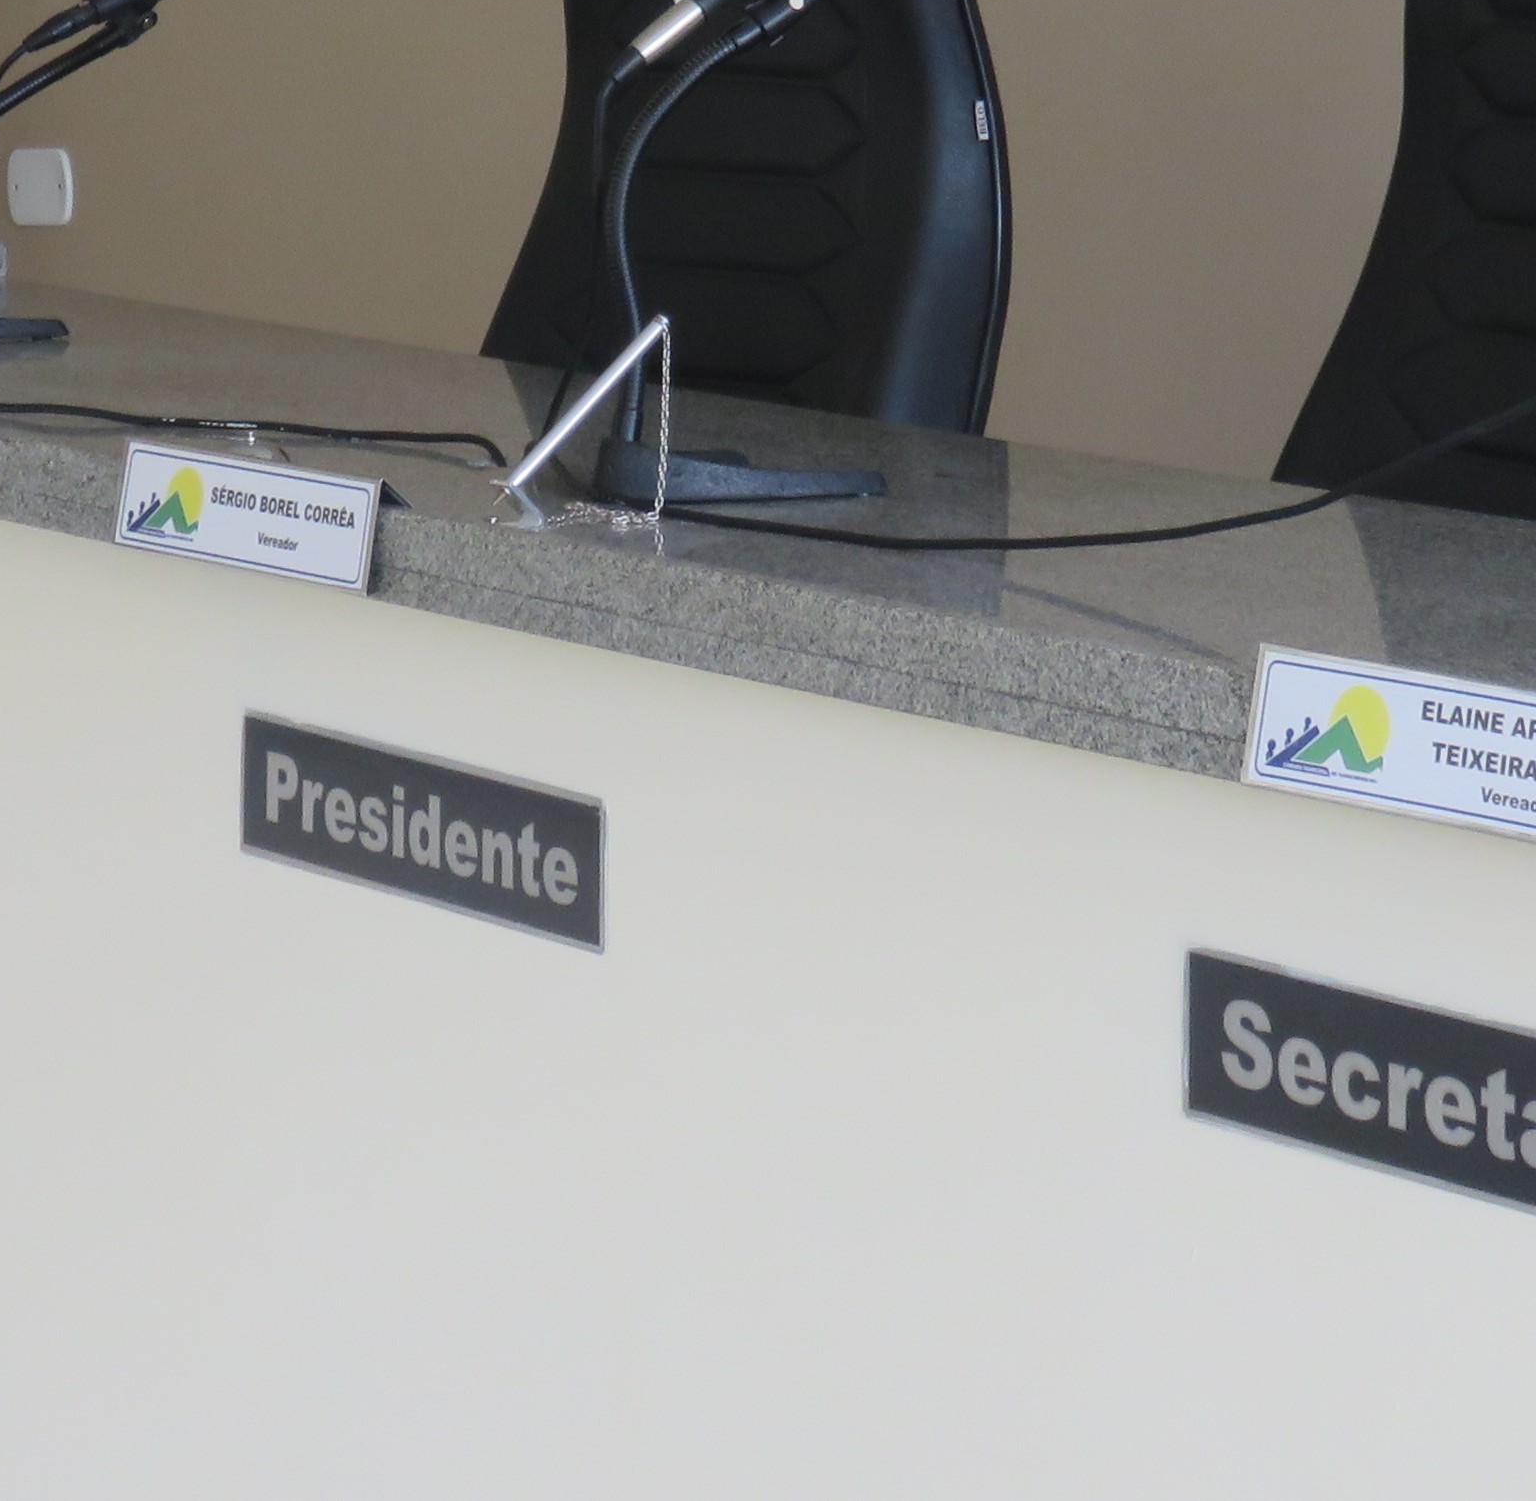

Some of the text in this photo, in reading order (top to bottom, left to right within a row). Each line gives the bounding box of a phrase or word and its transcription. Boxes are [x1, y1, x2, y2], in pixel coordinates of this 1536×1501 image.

[210, 484, 257, 511] SÉRGIO
[259, 495, 301, 519] BOREL
[257, 531, 300, 552] Vereador
[1420, 699, 1505, 734] ELAINE
[265, 749, 581, 907] Presidente
